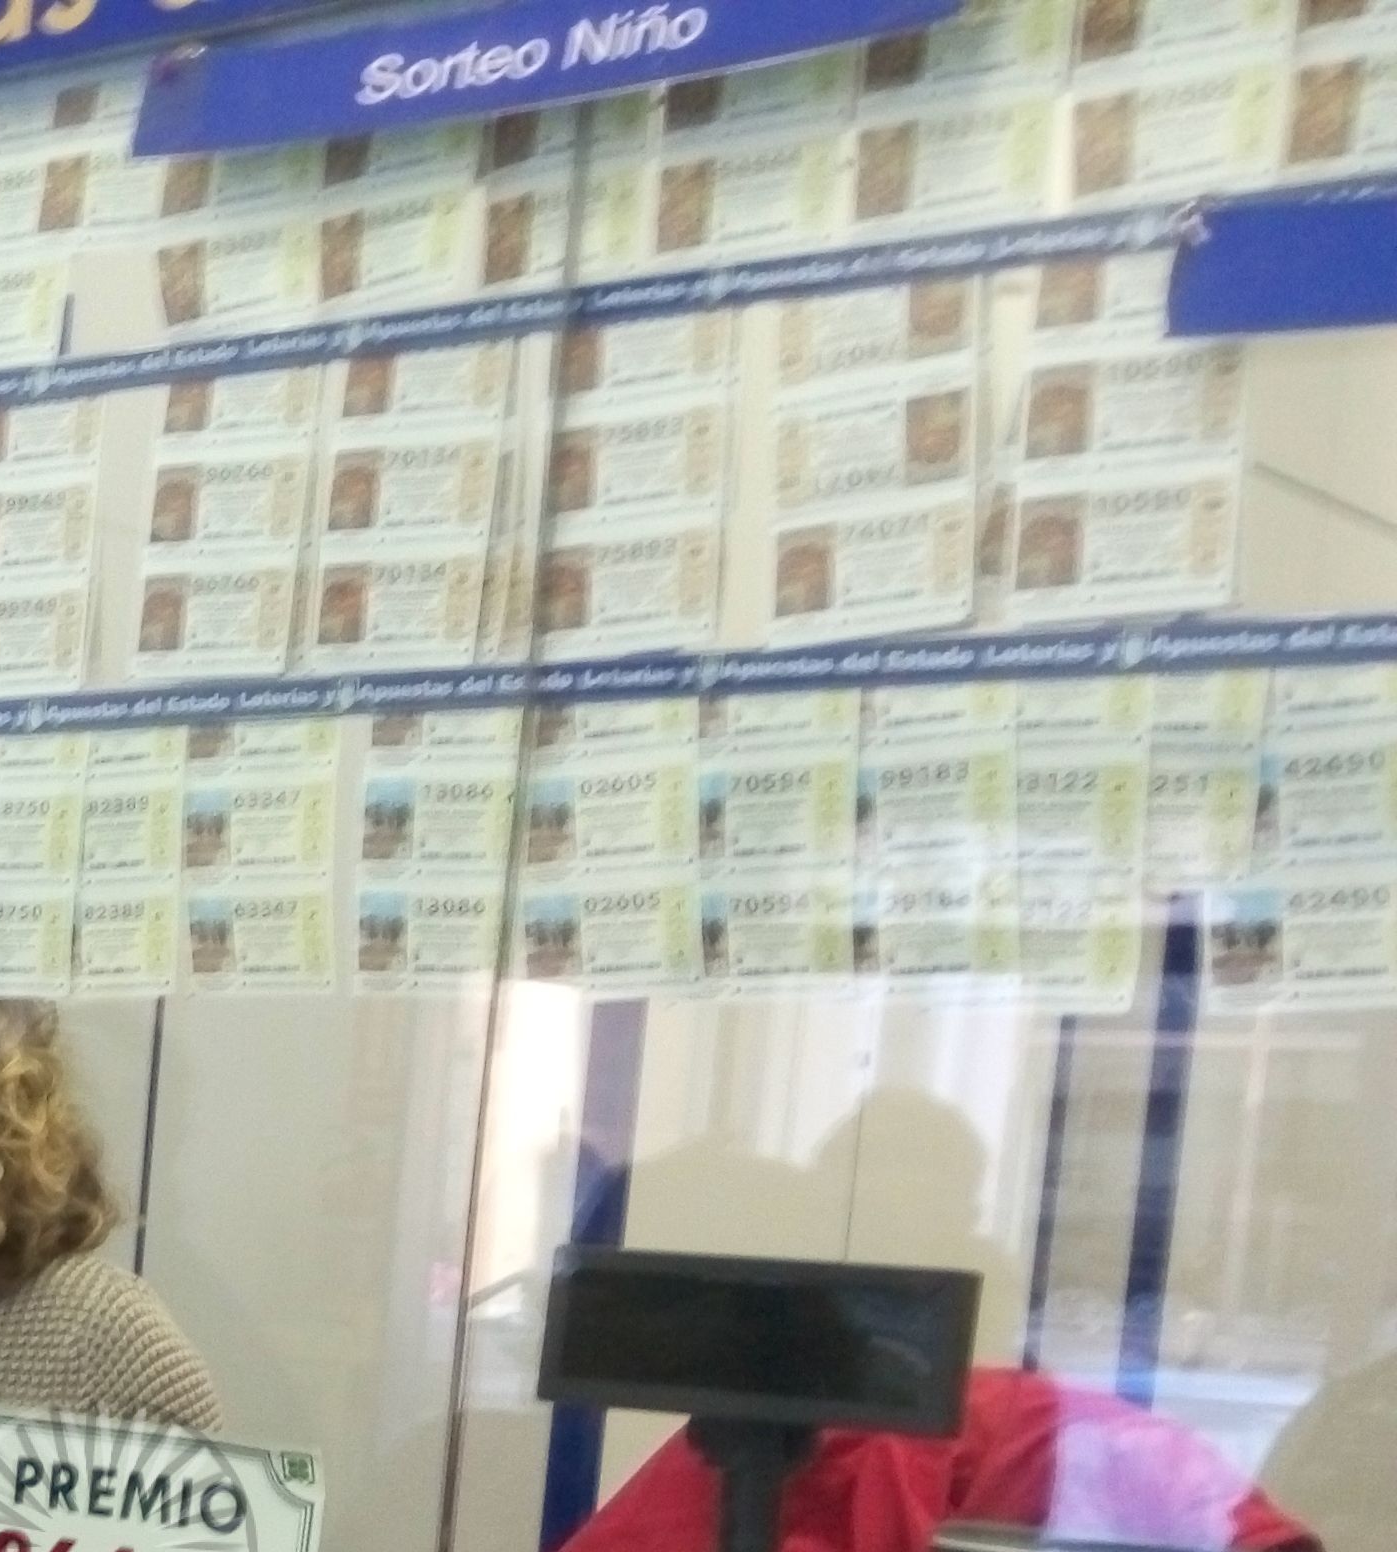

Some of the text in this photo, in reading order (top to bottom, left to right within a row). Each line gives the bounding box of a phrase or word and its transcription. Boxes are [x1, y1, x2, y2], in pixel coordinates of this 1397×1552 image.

[356, 3, 707, 106] Sorteo Niño
[131, 698, 162, 716] del
[167, 694, 230, 714] Estado
[459, 676, 494, 696] del
[842, 650, 879, 671] del
[887, 646, 974, 670] Estado
[1286, 626, 1335, 650] del
[15, 1457, 246, 1534] PREMIO
